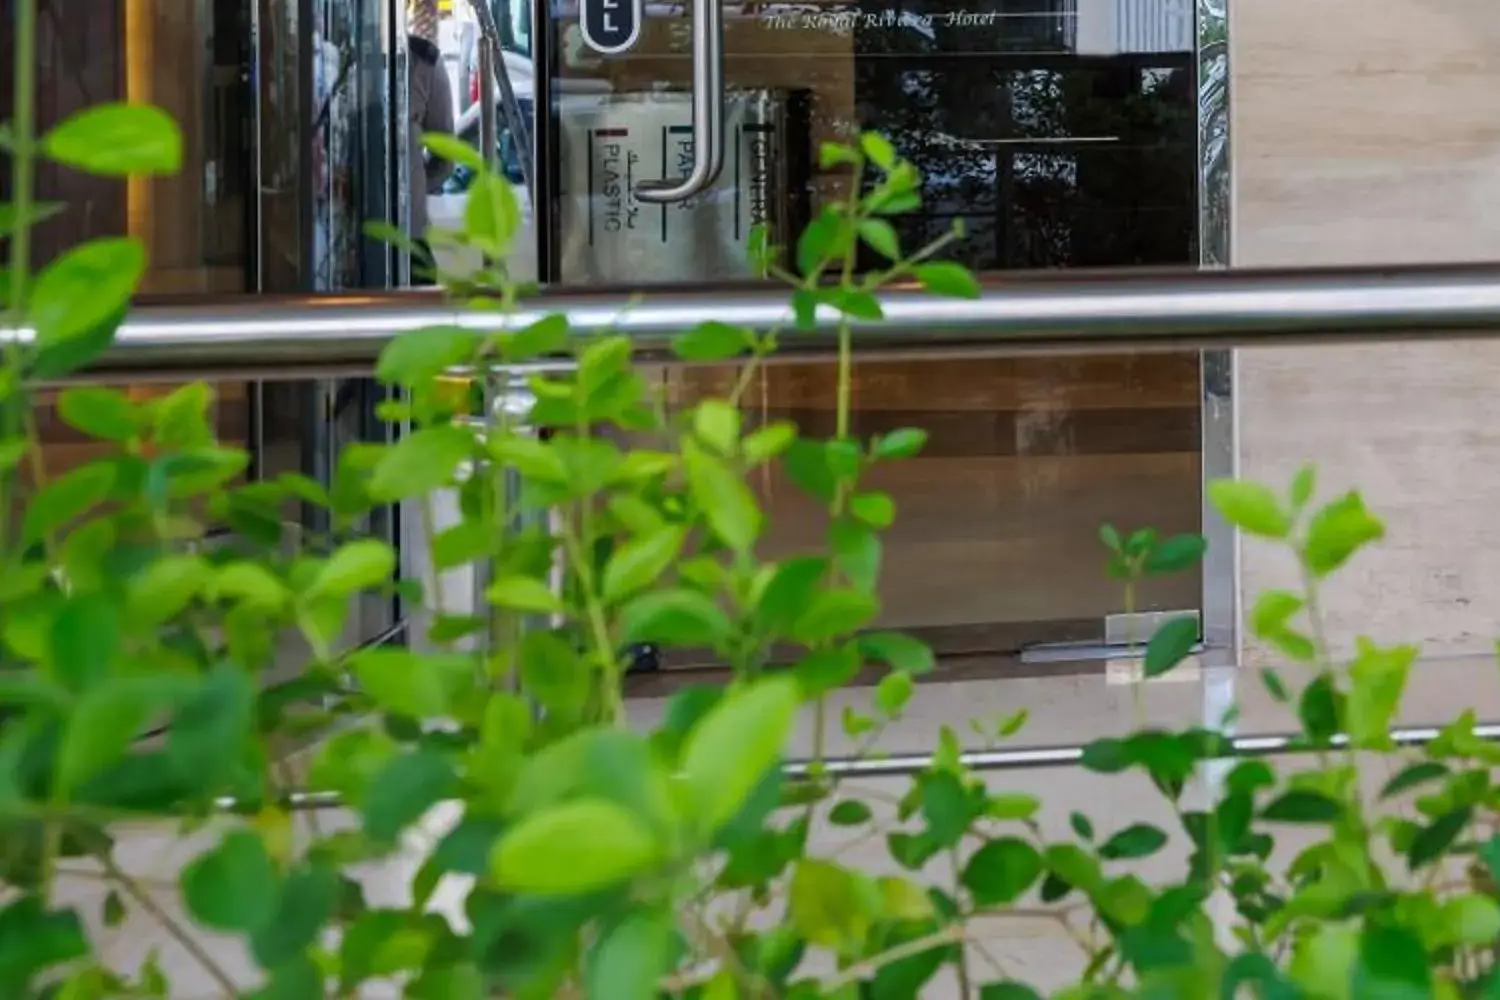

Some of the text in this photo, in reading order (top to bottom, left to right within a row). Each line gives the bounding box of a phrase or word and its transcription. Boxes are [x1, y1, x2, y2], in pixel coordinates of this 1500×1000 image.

[765, 12, 793, 29] The
[944, 8, 997, 28] Hotel
[602, 144, 621, 232] PLASTIC
[678, 140, 695, 210] PAPR
